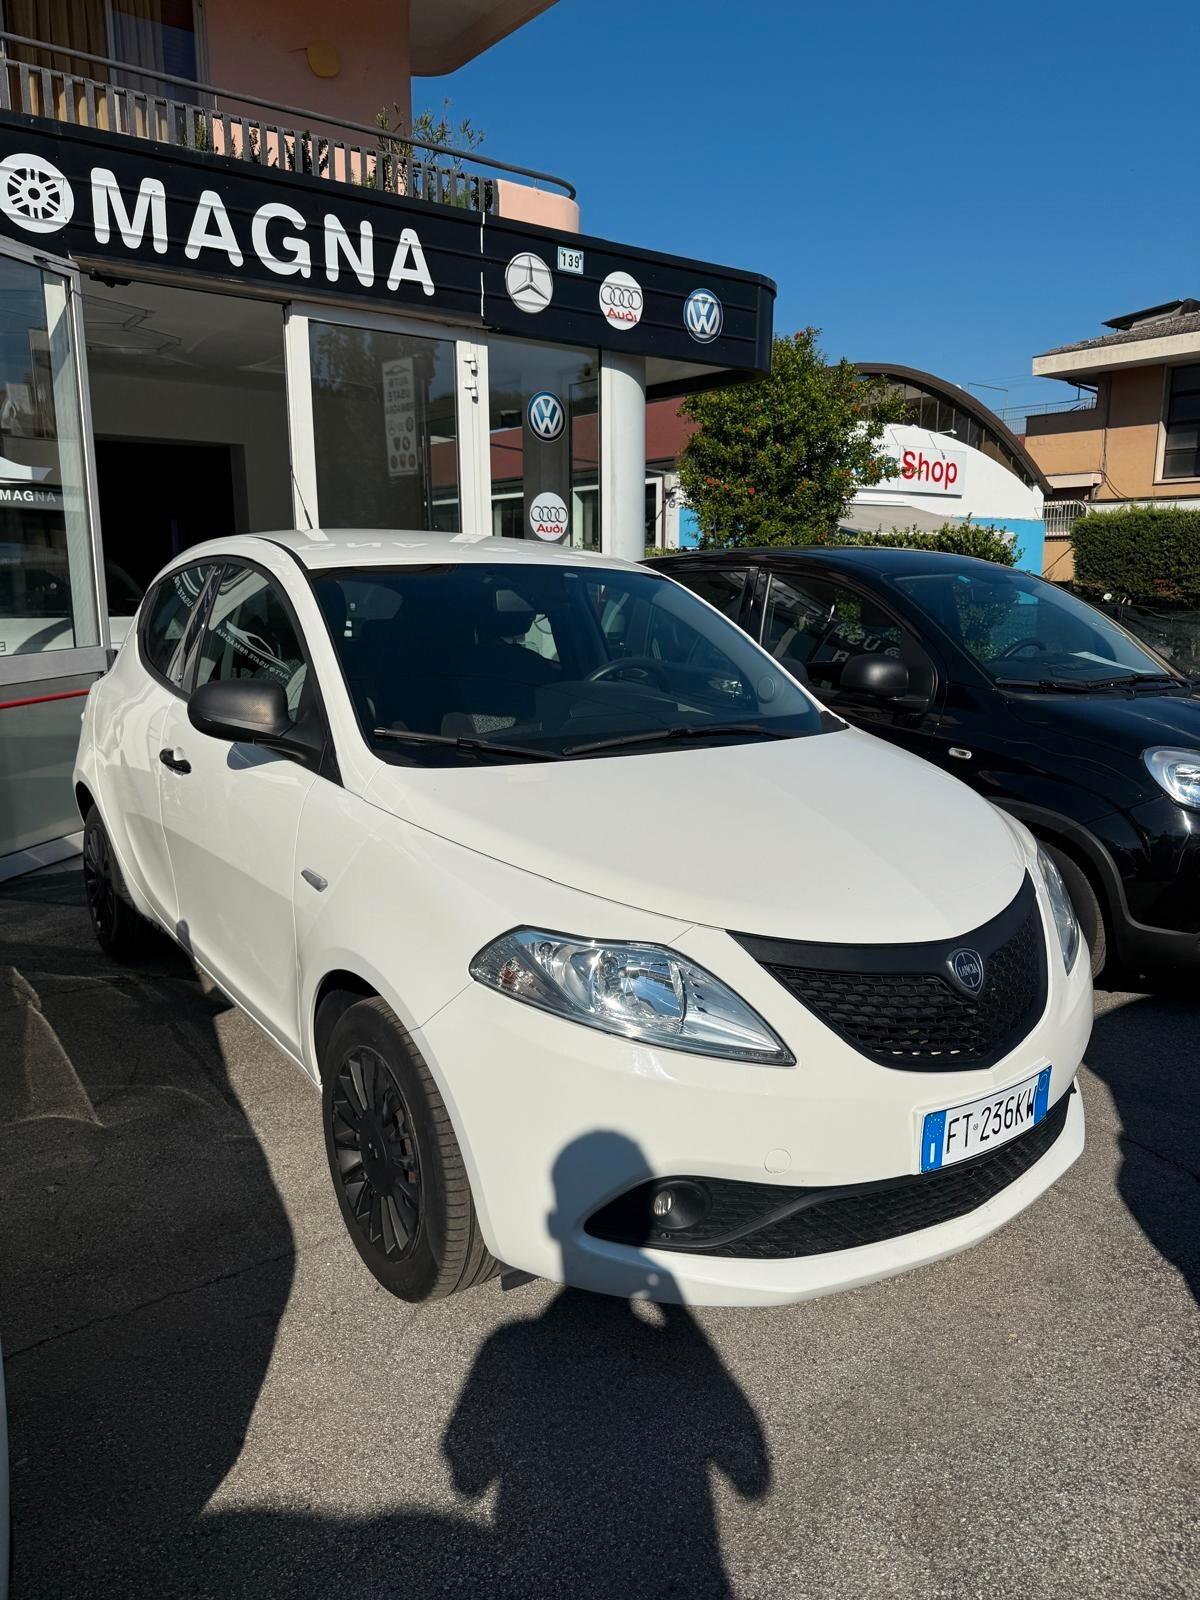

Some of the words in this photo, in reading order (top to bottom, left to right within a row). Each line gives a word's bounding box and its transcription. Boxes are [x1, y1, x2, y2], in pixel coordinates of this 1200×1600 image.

[562, 252, 580, 269] 139
[606, 307, 638, 323] Audi
[902, 451, 958, 490] Shop
[536, 523, 564, 534] Audi
[946, 1113, 974, 1155] FT
[979, 1084, 1039, 1142] 236KW
